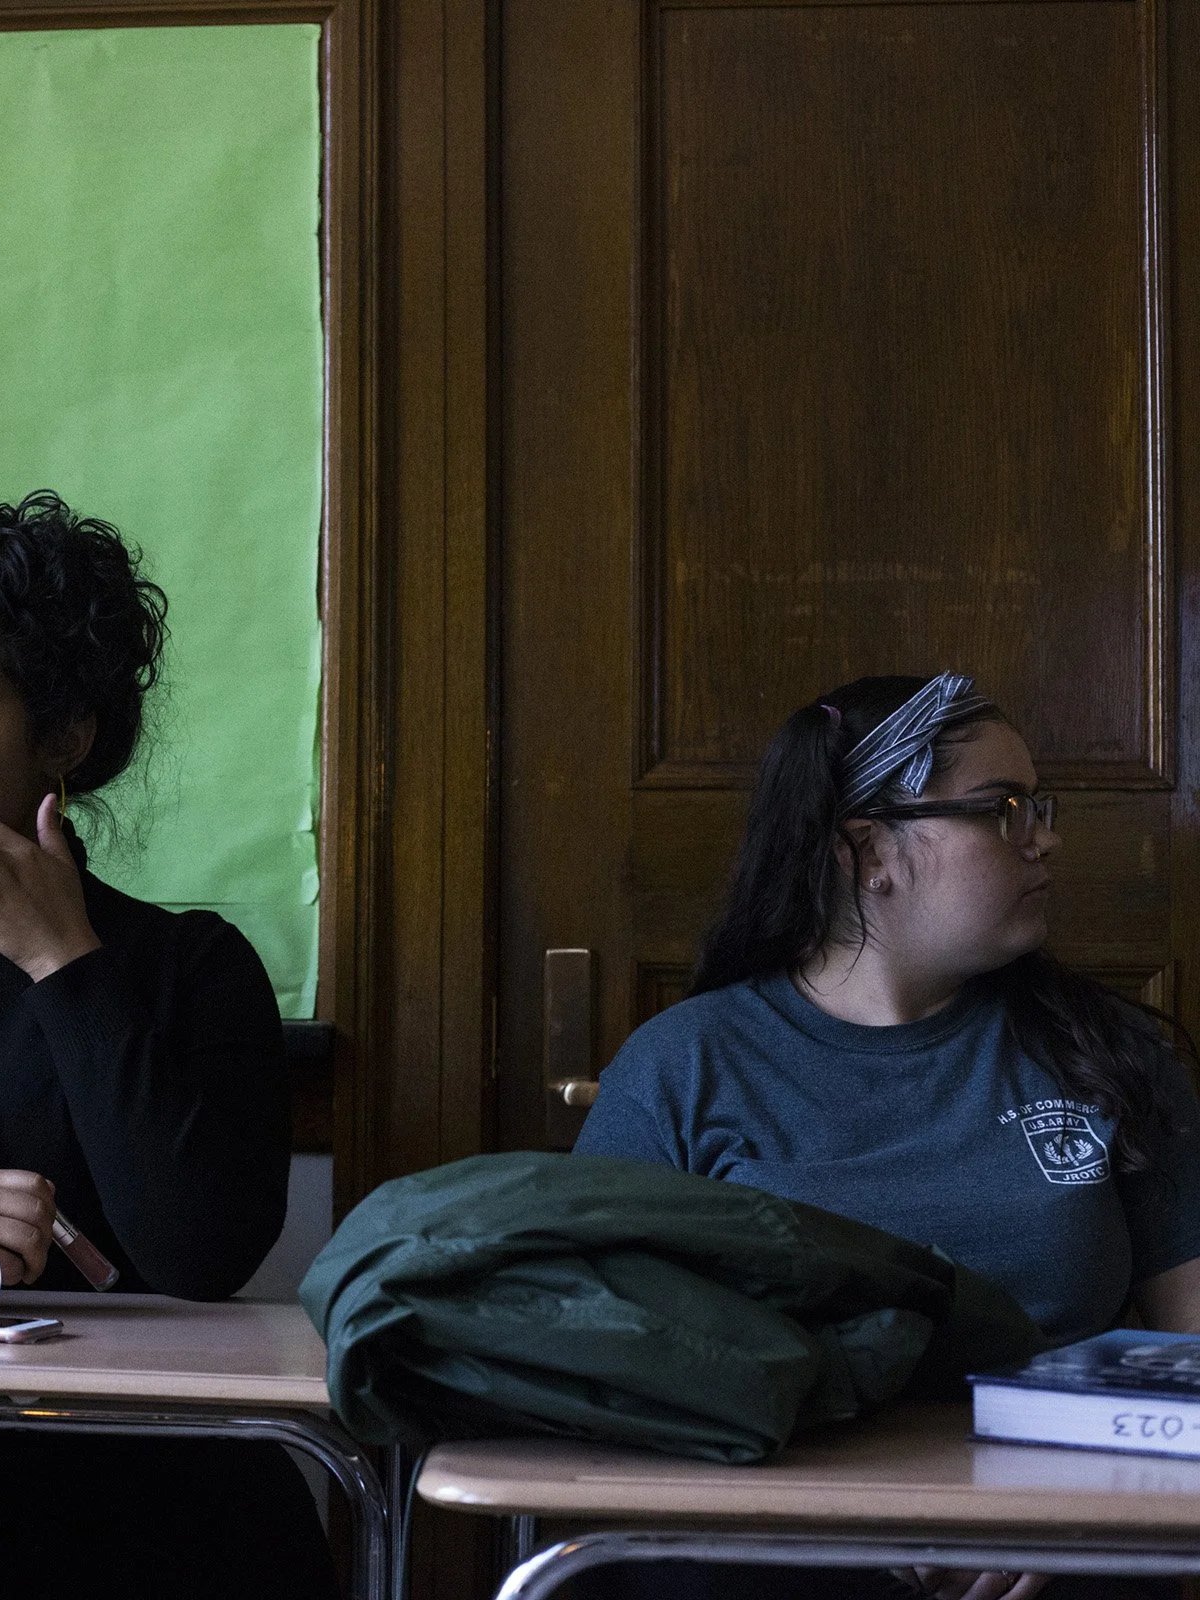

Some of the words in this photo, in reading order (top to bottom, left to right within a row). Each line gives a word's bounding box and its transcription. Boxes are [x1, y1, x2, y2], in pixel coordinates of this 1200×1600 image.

[1021, 1104, 1033, 1115] OF
[1035, 1099, 1100, 1114] COMMERC
[1062, 1166, 1106, 1182] JROTC
